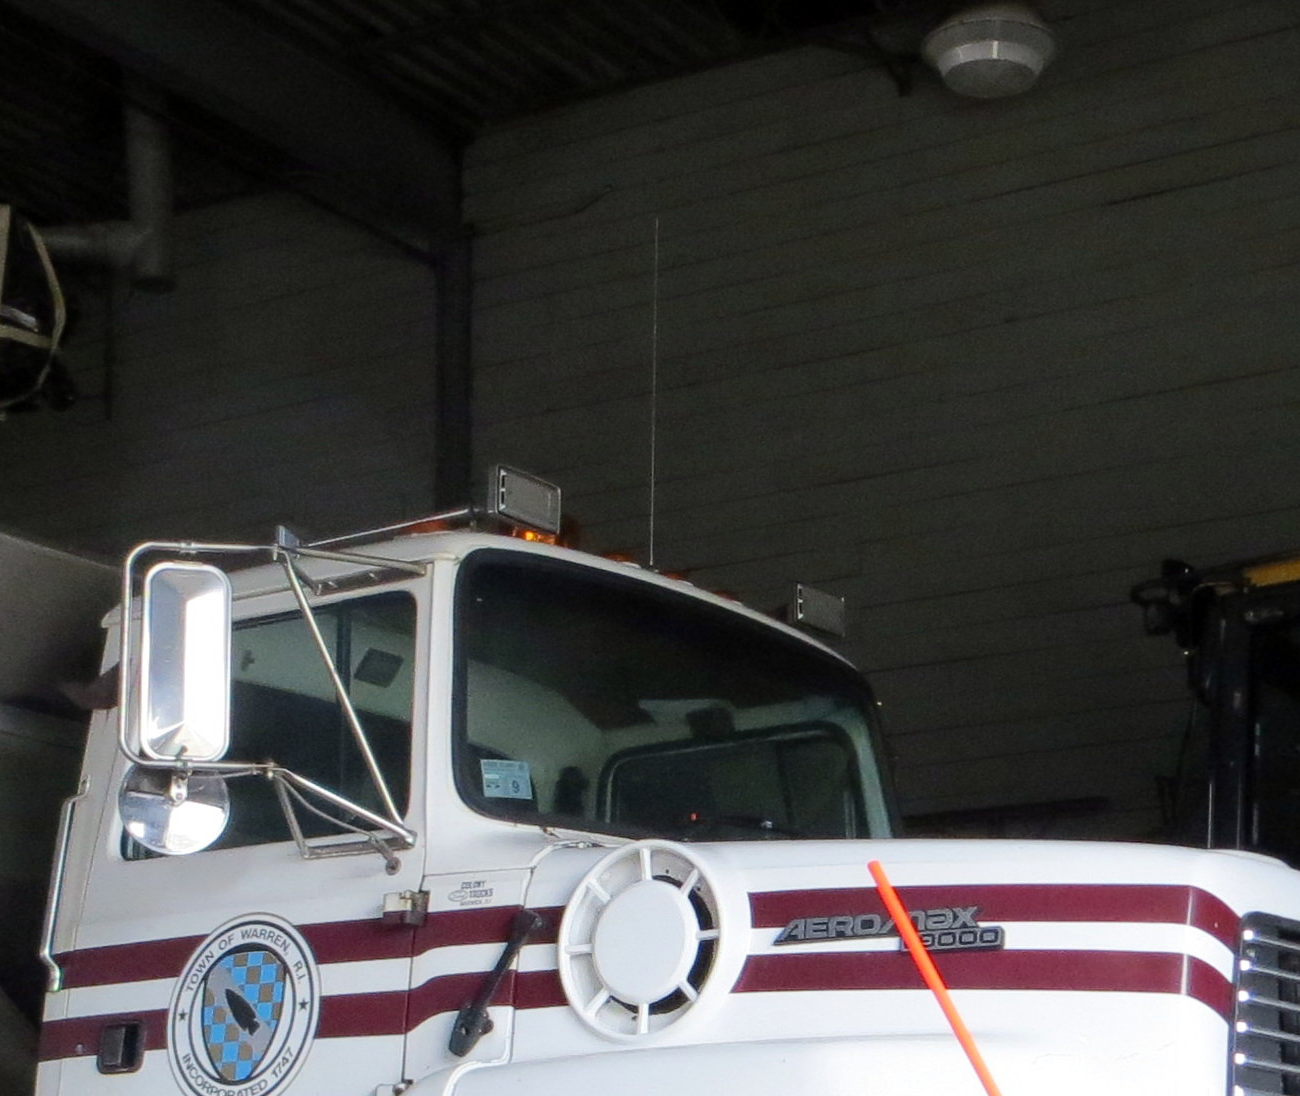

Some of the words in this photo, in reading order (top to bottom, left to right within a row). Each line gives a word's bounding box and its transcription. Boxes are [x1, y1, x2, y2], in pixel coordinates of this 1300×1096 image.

[186, 951, 215, 992] TOWN
[218, 933, 235, 950] OF
[271, 1046, 294, 1080] 1747
